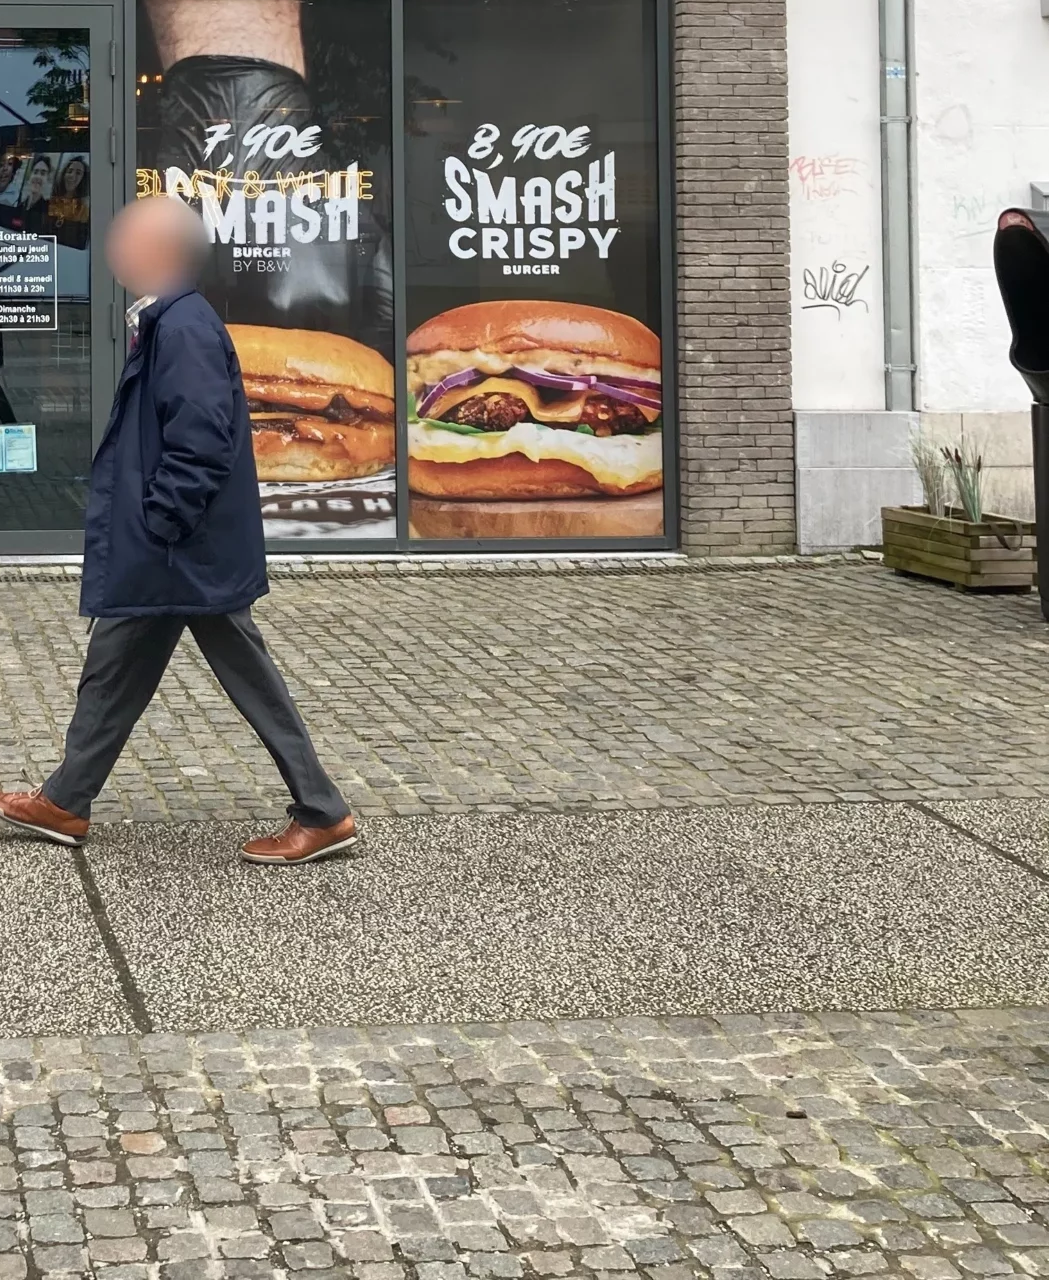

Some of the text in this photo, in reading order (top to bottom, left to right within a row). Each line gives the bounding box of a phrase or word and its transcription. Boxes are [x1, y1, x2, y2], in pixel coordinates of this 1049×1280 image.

[276, 170, 374, 200] WHITE
[443, 150, 616, 225] SMASH
[448, 227, 619, 259] CRISPY
[28, 245, 49, 254] jeudi
[233, 247, 292, 258] BURGER
[25, 254, 49, 262] 22h30
[233, 260, 292, 272] BY B&W
[502, 265, 561, 275] BURGER
[0, 285, 22, 293] 11h30
[30, 285, 45, 293] 23h
[26, 314, 50, 323] 21h30
